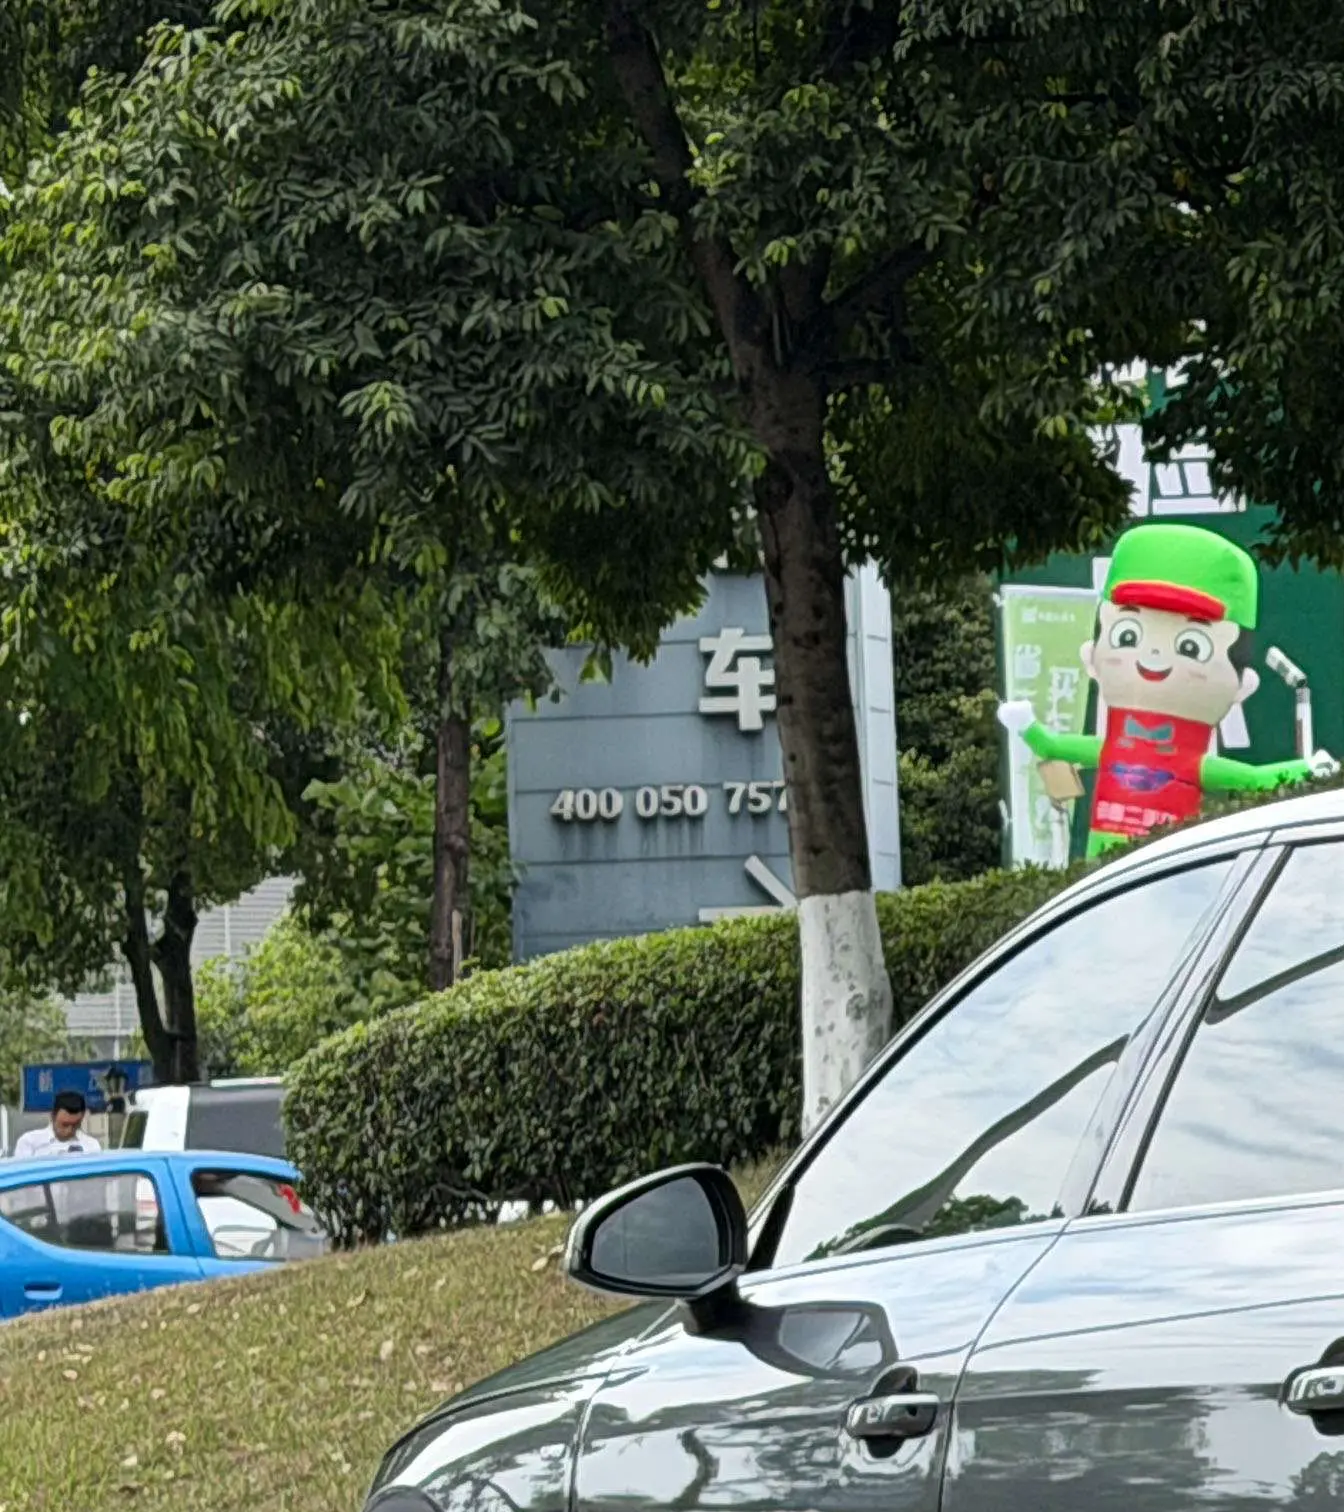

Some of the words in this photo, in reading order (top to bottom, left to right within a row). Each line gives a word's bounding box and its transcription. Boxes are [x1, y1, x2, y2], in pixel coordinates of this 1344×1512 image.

[699, 627, 777, 731] 车
[550, 788, 623, 821] 400
[635, 785, 708, 817] 050
